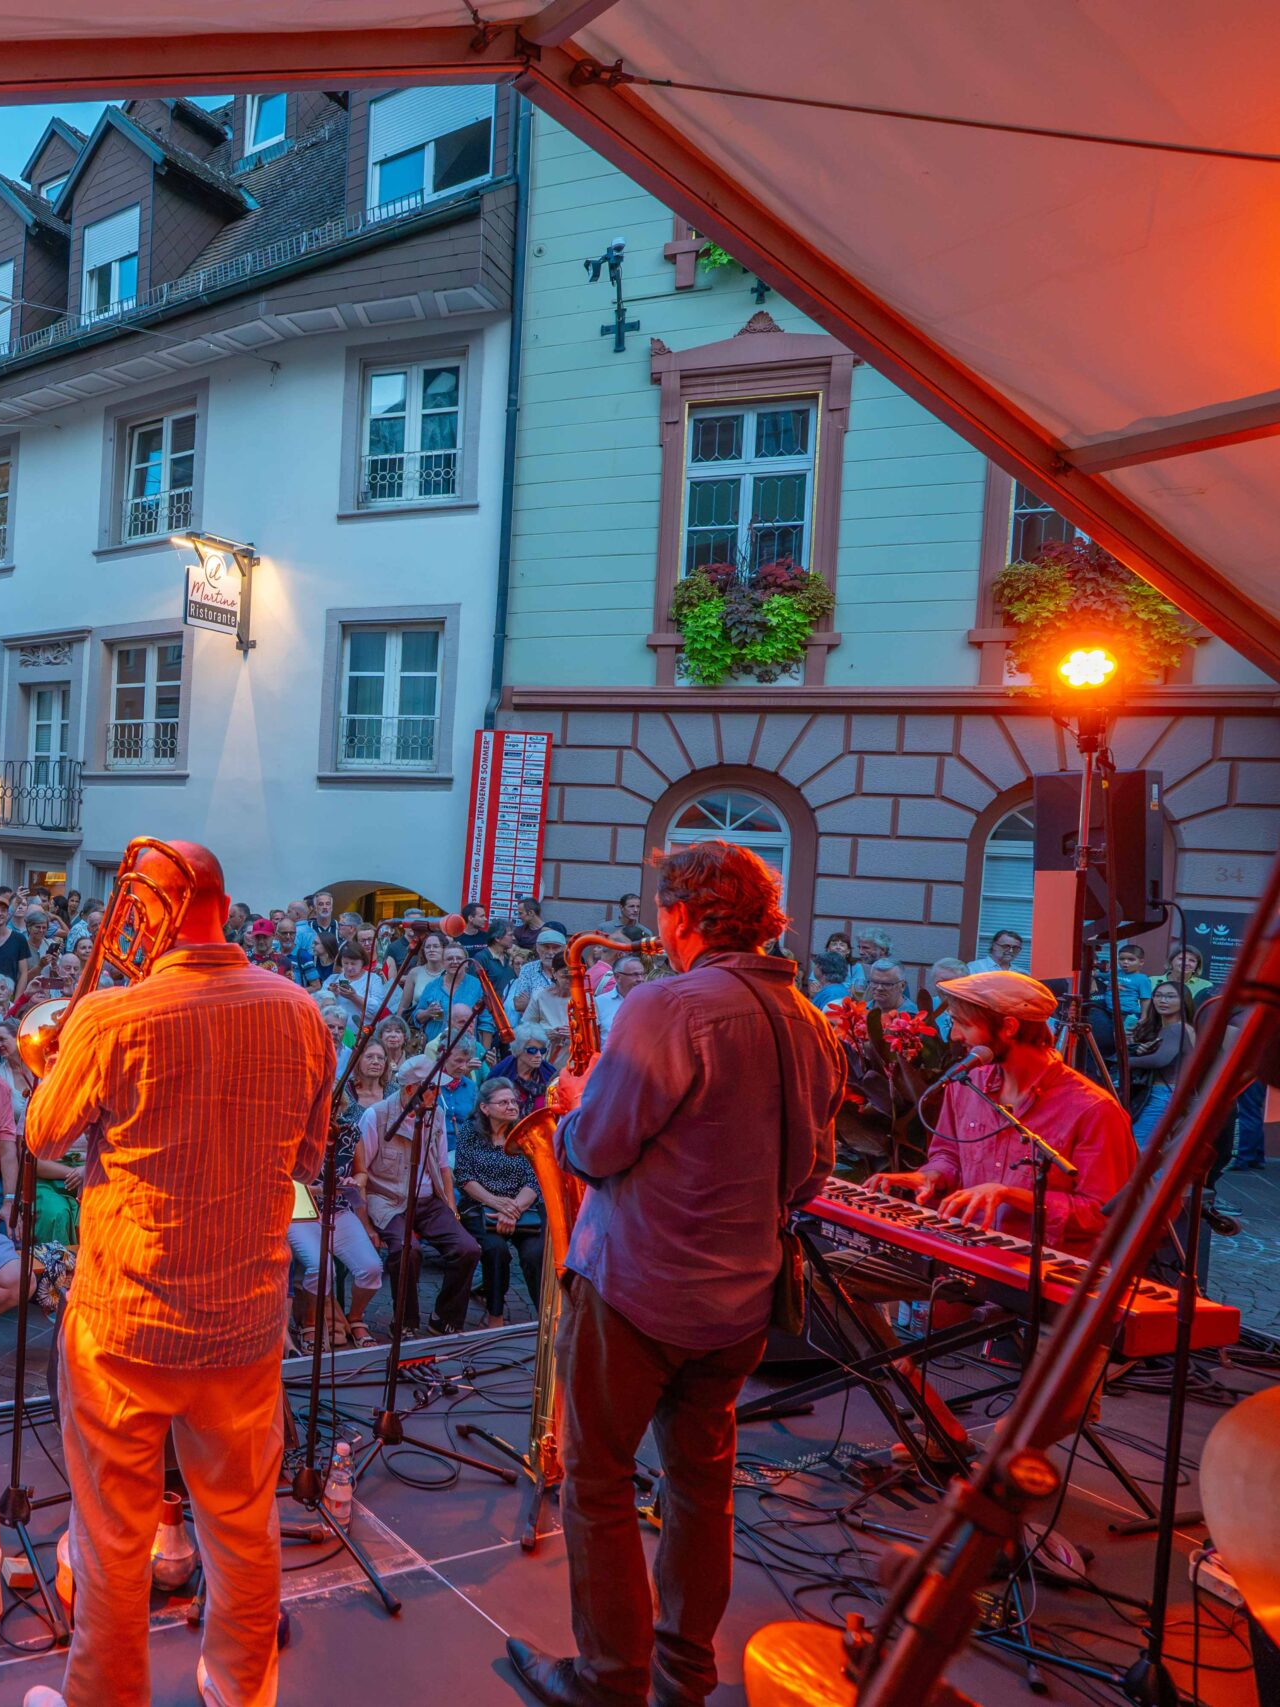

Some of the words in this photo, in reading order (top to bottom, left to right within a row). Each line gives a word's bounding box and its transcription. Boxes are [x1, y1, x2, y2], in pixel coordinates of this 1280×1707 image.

[191, 581, 237, 607] Martino
[190, 603, 236, 626] Ristorante
[474, 825, 483, 856] Jazzfest
[1216, 867, 1244, 882] 34
[471, 874, 479, 902] stützen
